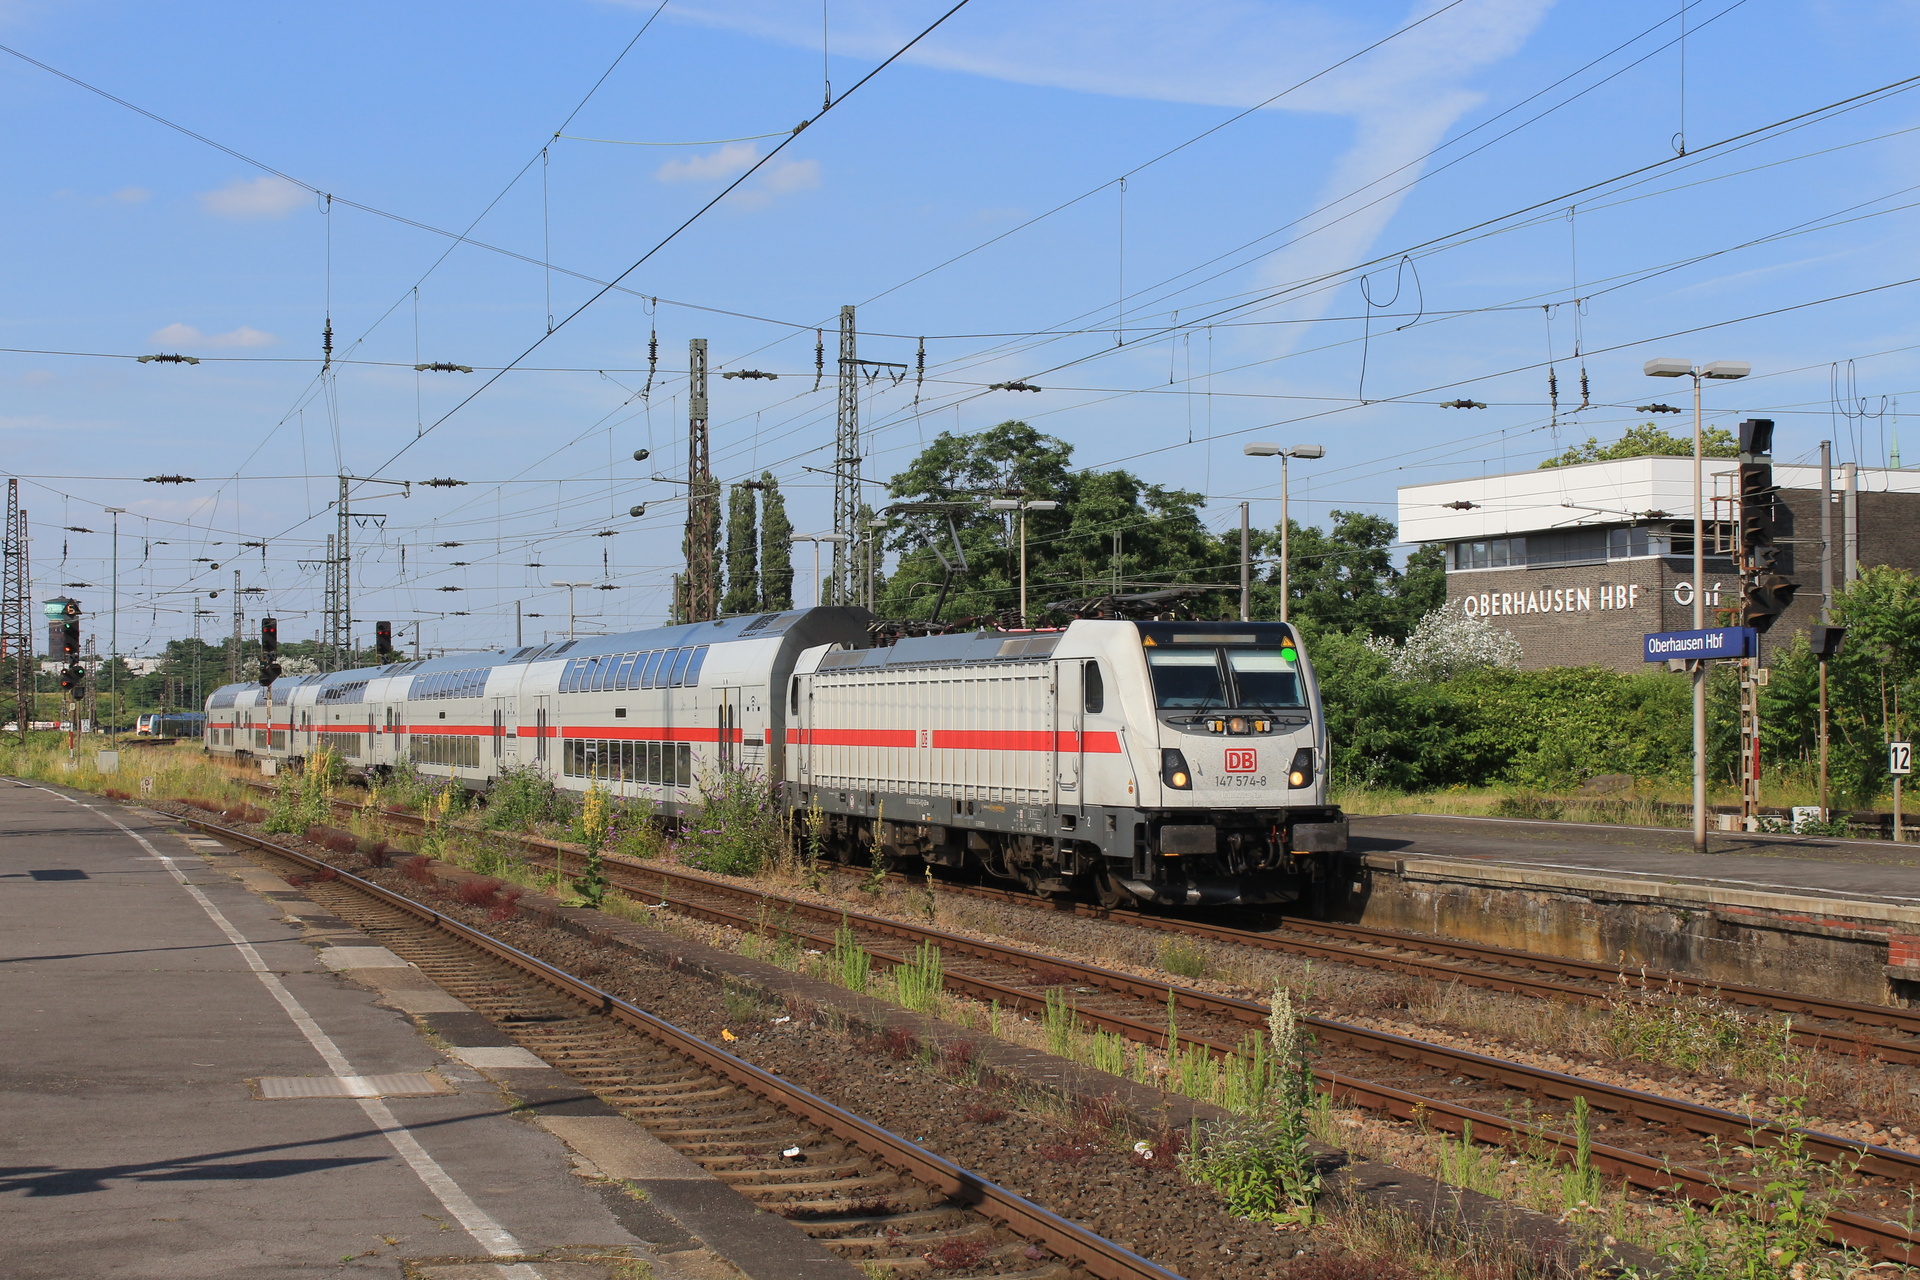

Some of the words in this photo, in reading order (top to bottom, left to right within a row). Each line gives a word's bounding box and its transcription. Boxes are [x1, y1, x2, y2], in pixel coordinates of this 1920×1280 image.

[1464, 587, 1591, 617] OBERHAUSEN
[1600, 584, 1638, 610] HBF
[1648, 637, 1703, 653] Oberhausen
[1705, 632, 1724, 649] Hbf
[1228, 751, 1254, 769] DB
[1892, 746, 1909, 770] 12
[1215, 775, 1233, 787] 147
[1236, 775, 1267, 787] 574-8
